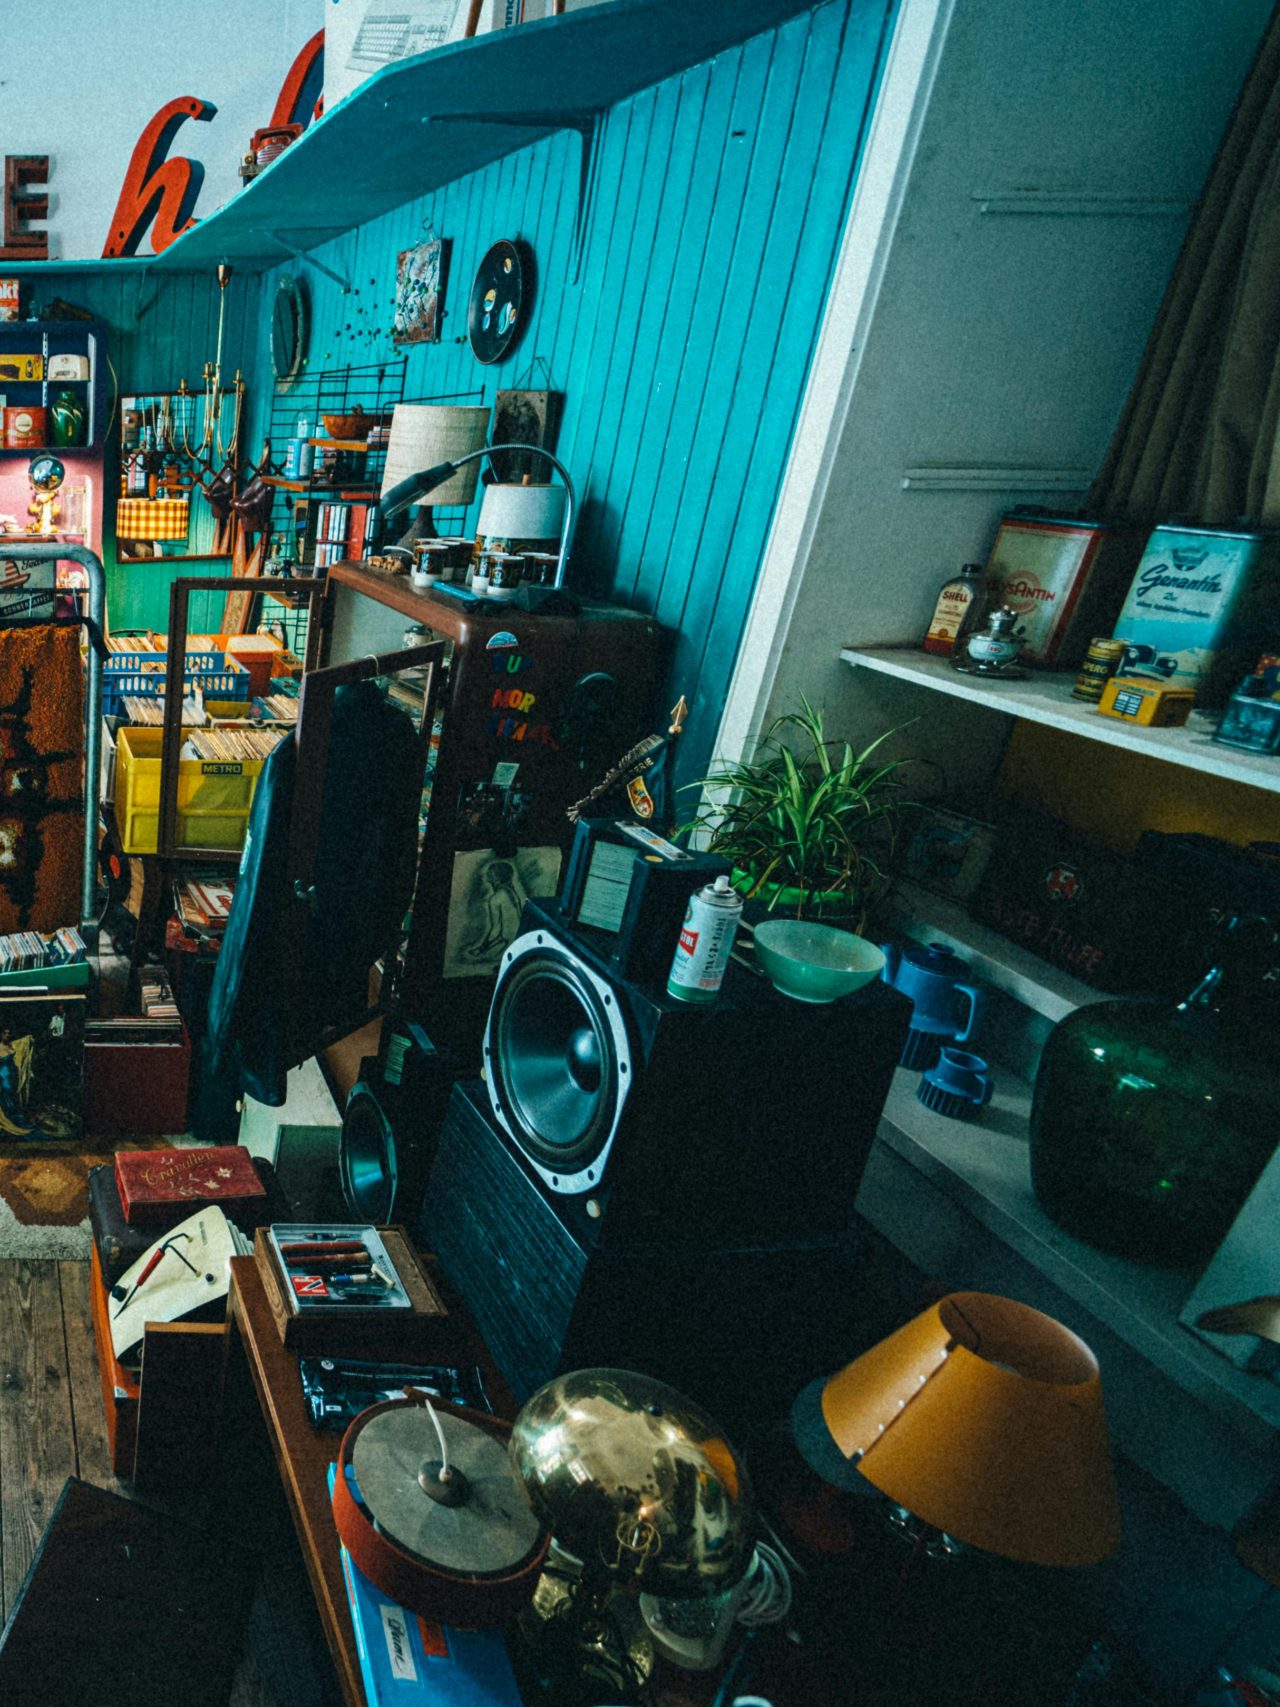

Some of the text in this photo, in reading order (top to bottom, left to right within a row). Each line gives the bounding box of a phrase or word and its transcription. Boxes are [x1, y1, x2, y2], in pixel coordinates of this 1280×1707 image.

[1135, 563, 1222, 597] Genantin
[942, 590, 968, 602] SHELL
[202, 764, 241, 774] METRO
